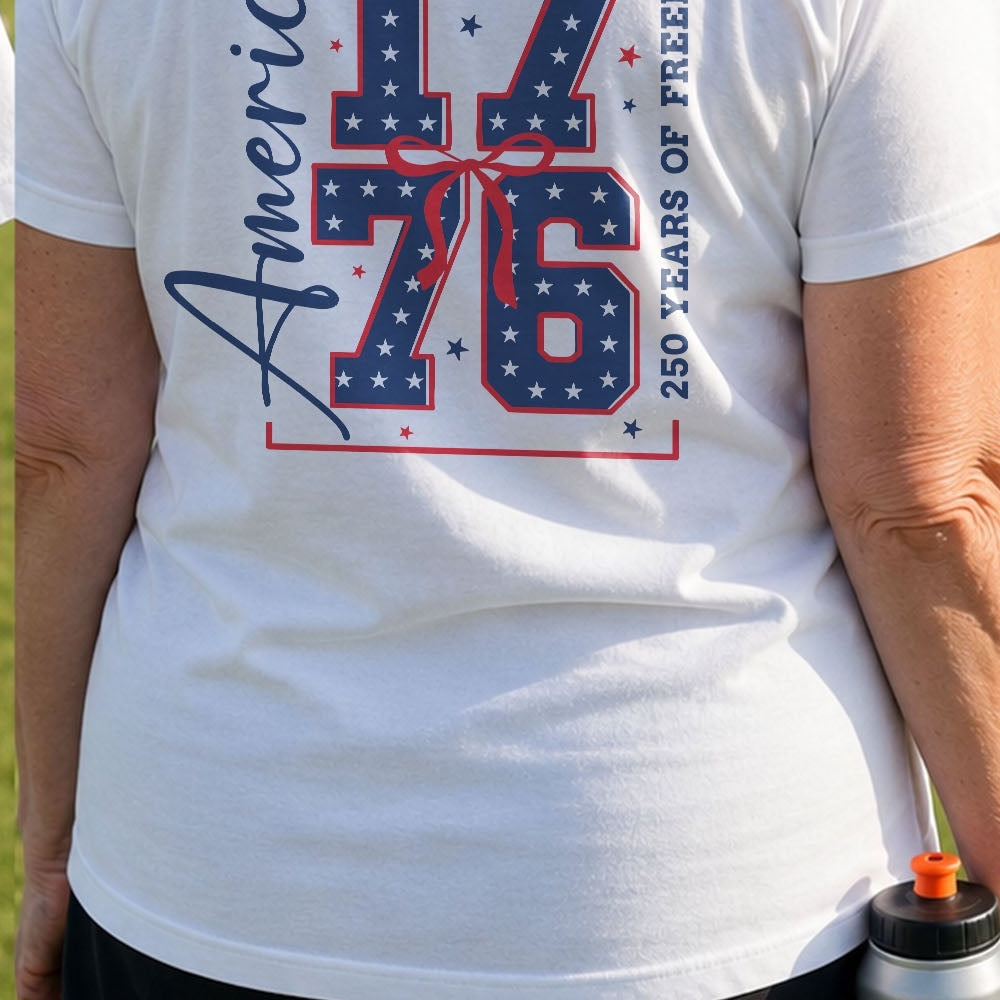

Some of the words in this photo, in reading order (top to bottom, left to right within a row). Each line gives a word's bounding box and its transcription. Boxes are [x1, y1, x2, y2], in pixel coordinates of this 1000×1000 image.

[660, 125, 688, 174] OF
[311, 163, 640, 415] 76
[660, 190, 688, 319] YEARS
[660, 334, 688, 400] 250
